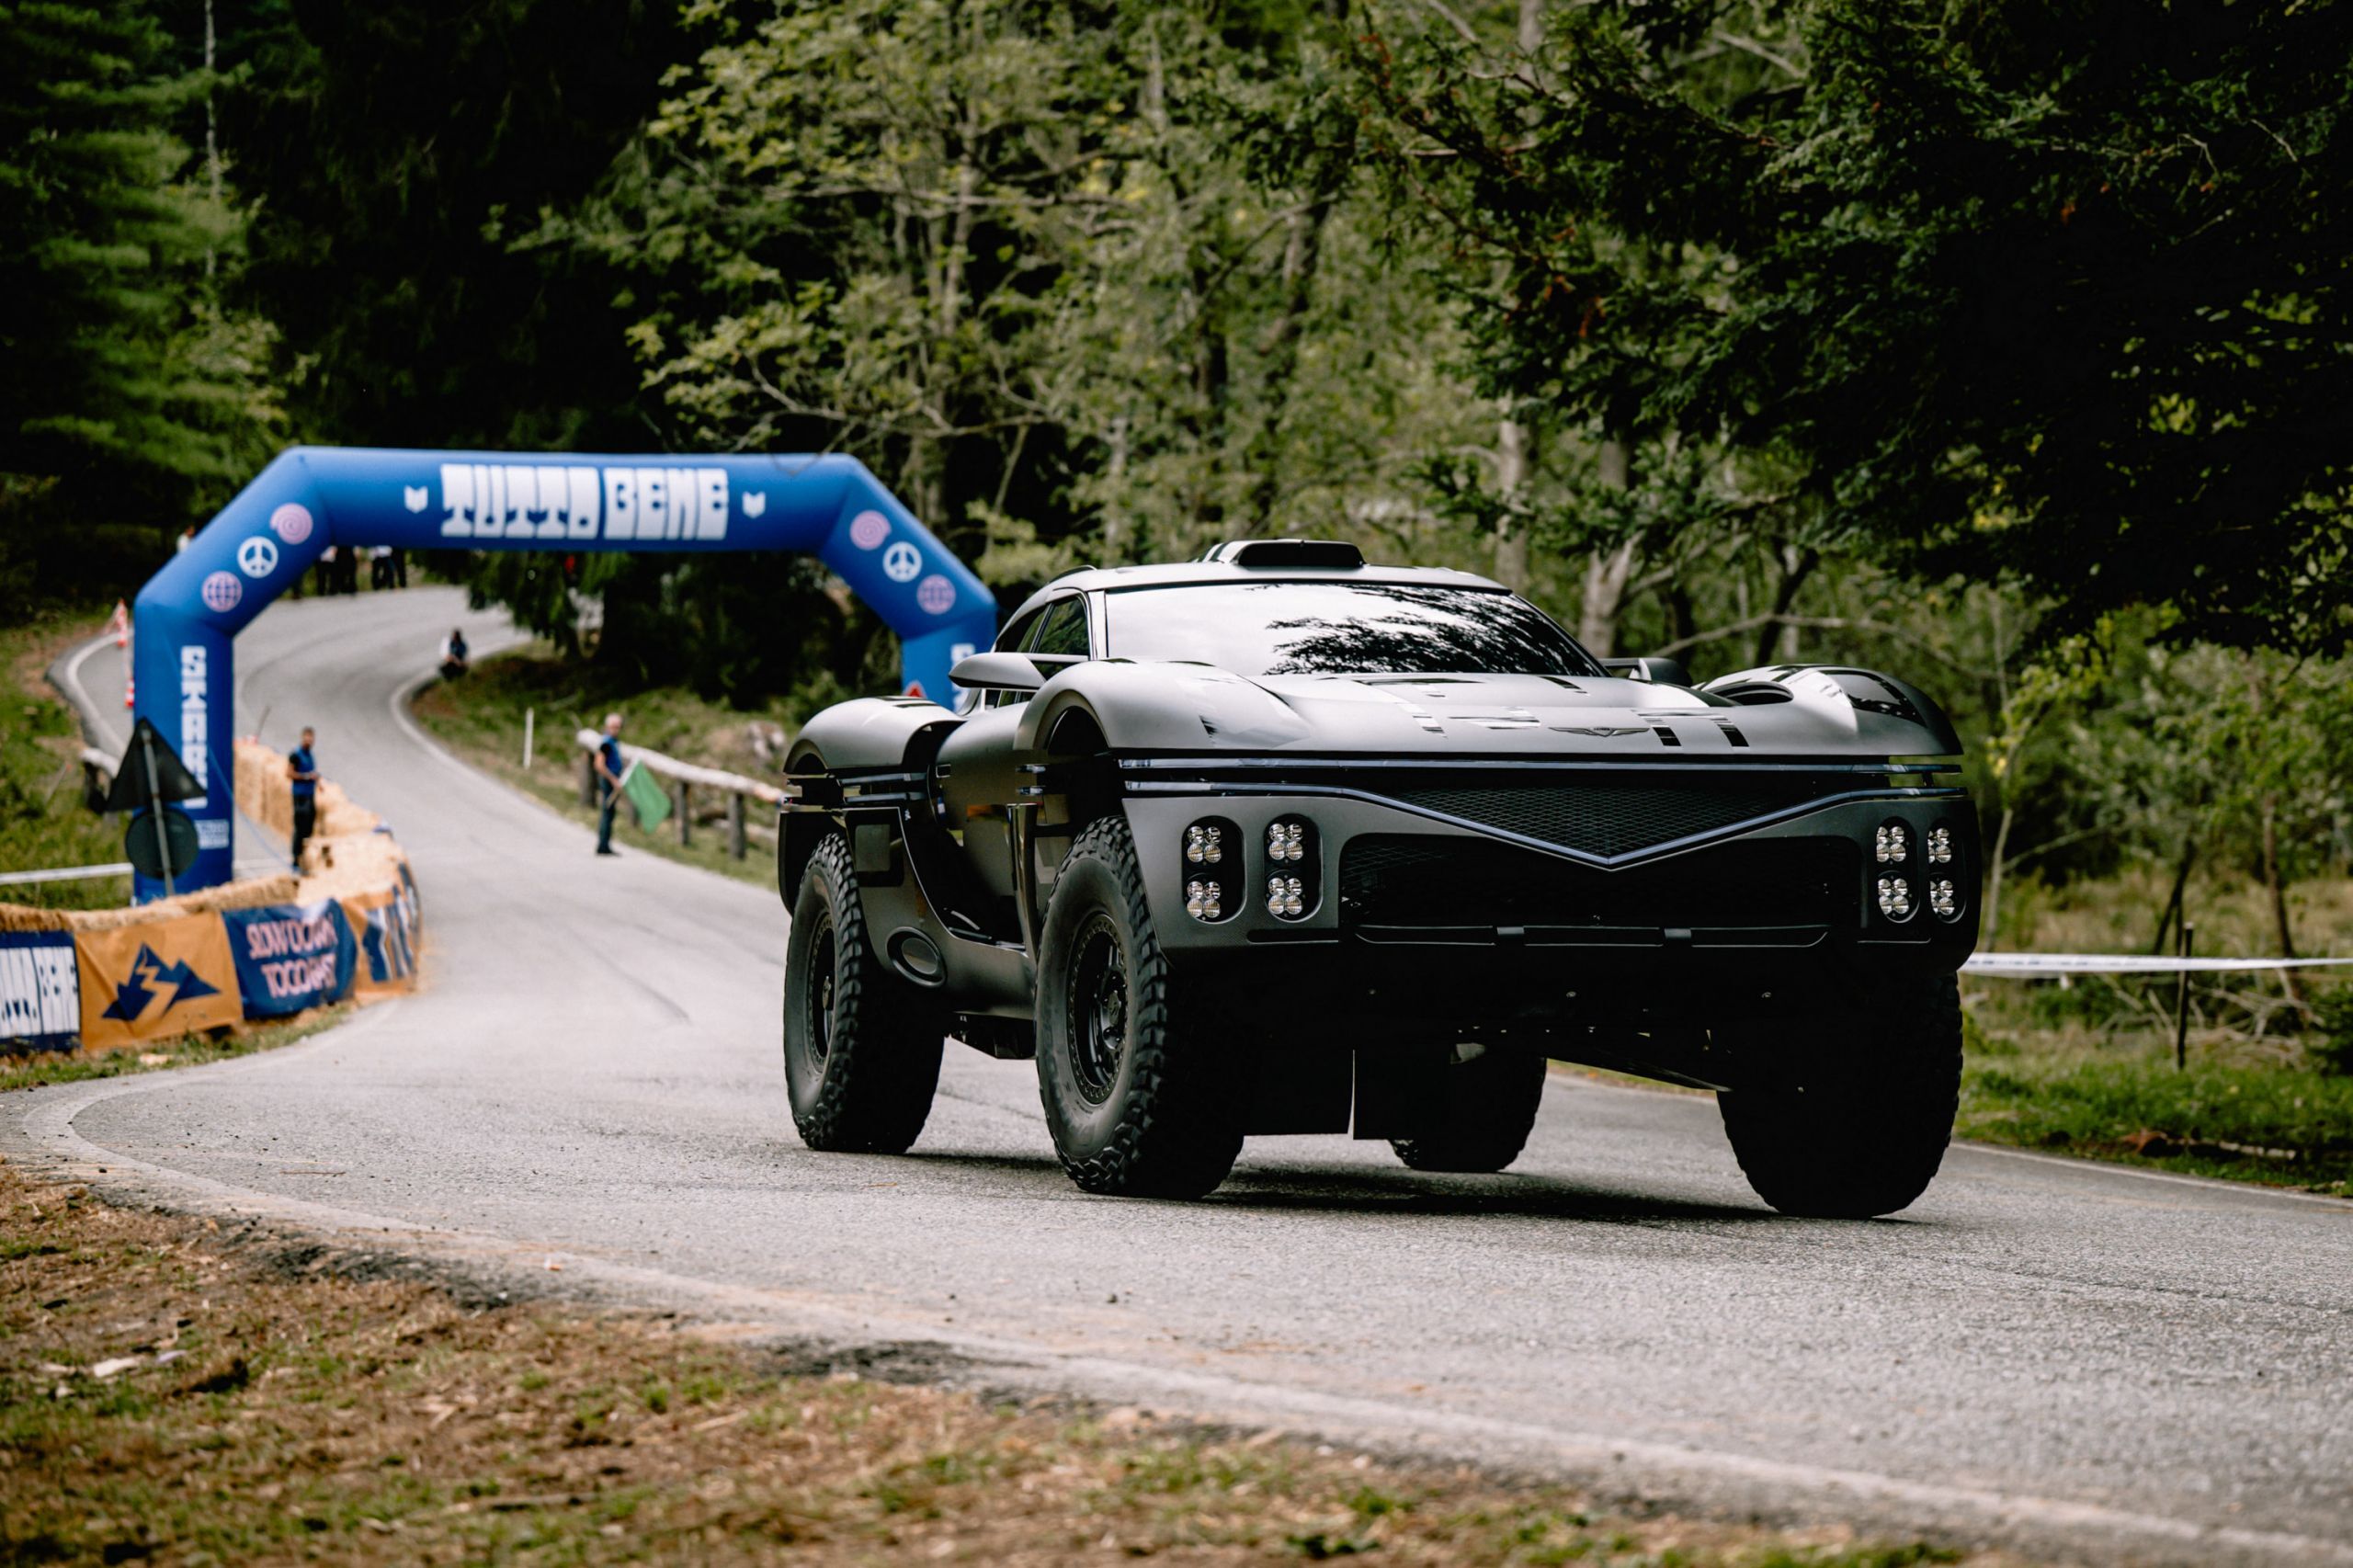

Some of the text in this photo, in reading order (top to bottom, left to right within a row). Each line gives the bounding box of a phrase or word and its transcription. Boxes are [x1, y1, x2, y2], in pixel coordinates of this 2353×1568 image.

[439, 463, 729, 540] TUTTO BENE
[30, 947, 81, 1034] BENE
